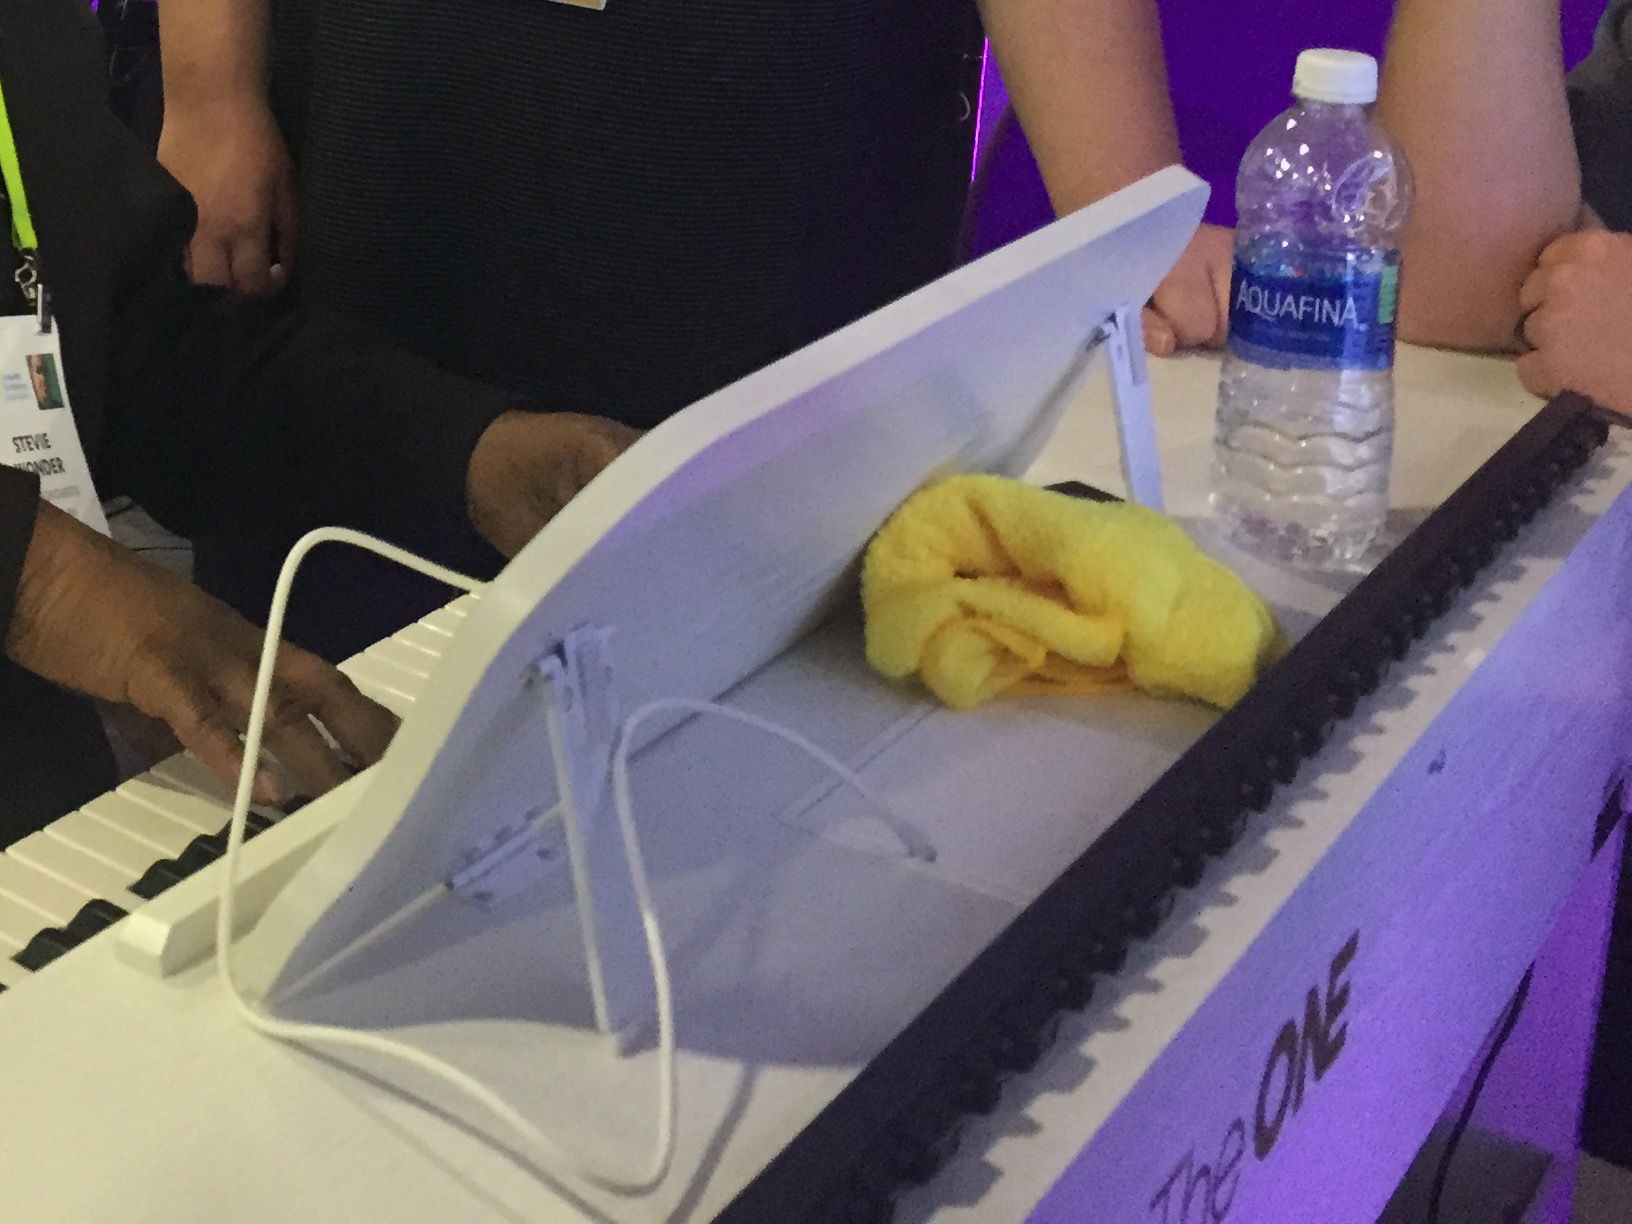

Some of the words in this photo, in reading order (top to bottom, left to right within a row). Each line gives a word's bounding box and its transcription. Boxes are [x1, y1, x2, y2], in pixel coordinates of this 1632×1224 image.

[1235, 279, 1358, 329] AQUAFINA
[11, 432, 52, 454] STEVIE
[1252, 928, 1361, 1162] ONE
